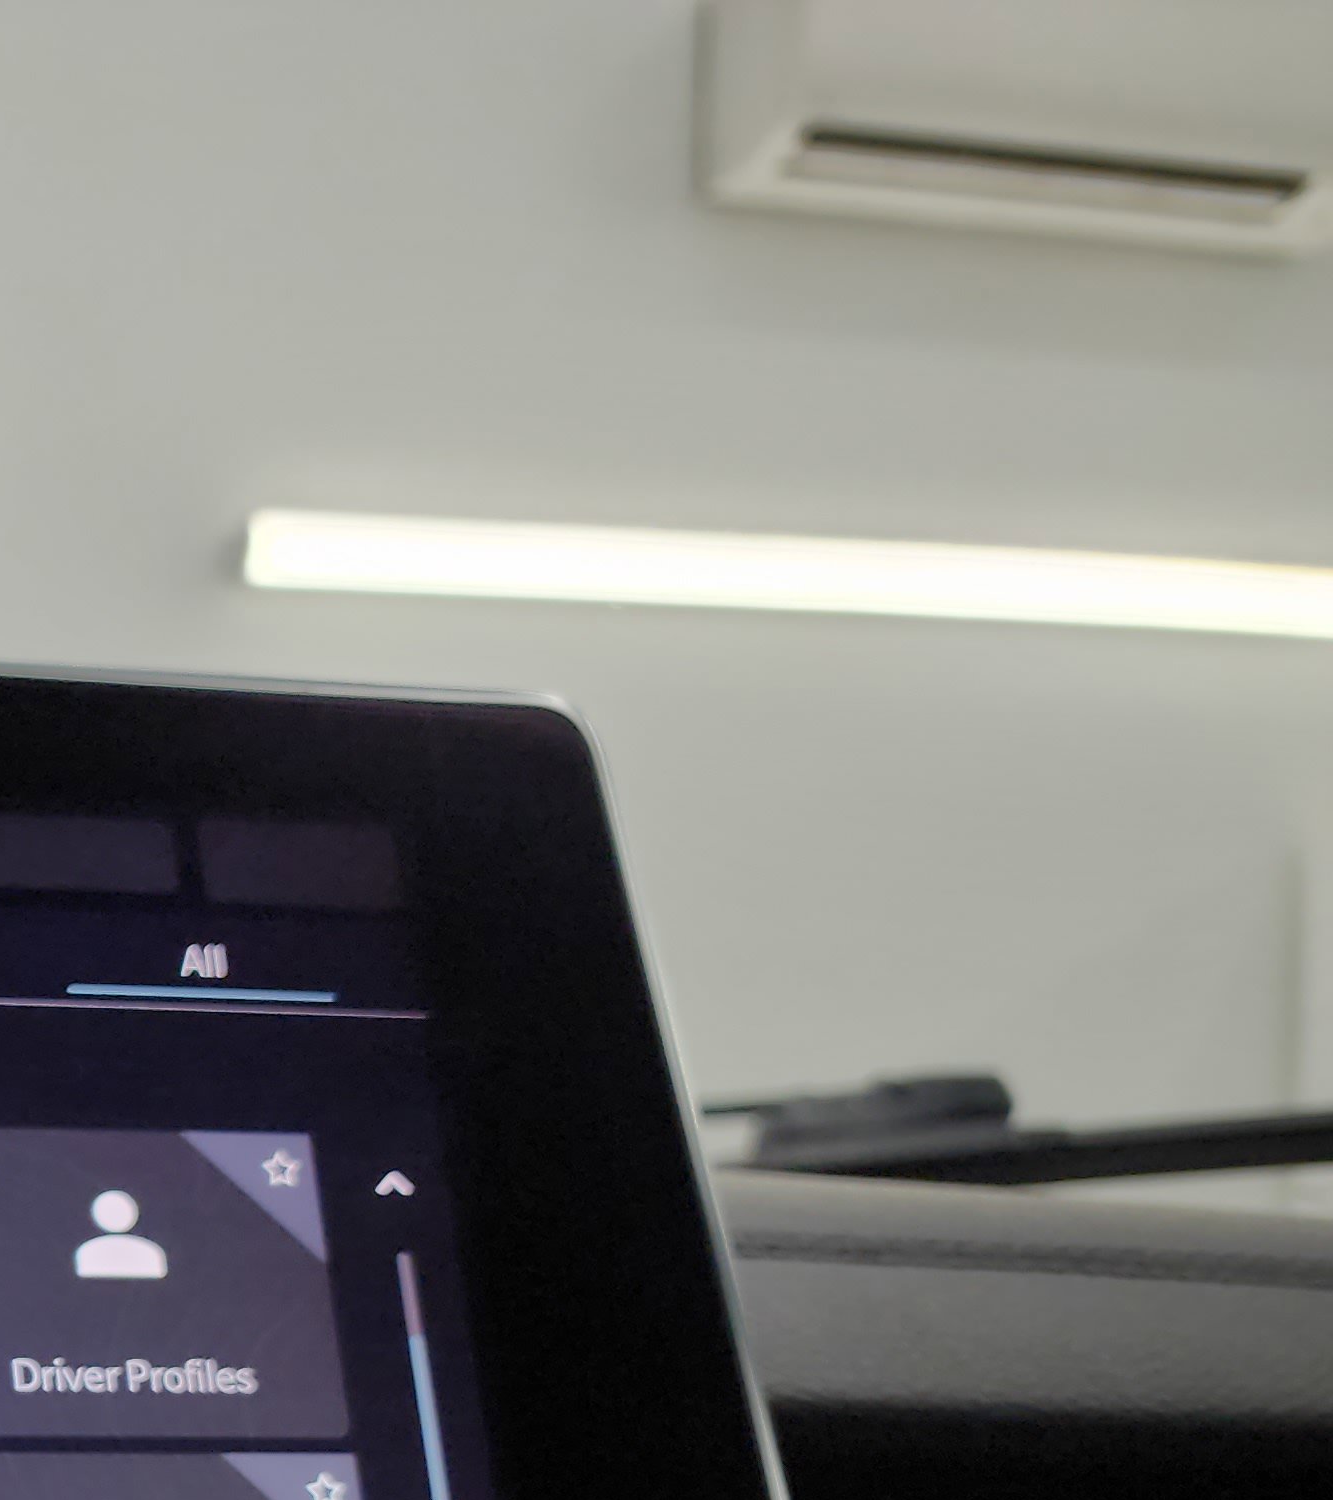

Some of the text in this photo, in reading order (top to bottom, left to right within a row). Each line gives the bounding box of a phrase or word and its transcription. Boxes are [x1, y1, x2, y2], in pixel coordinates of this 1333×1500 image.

[180, 943, 229, 979] All
[11, 1357, 259, 1395] Driver Profiles
